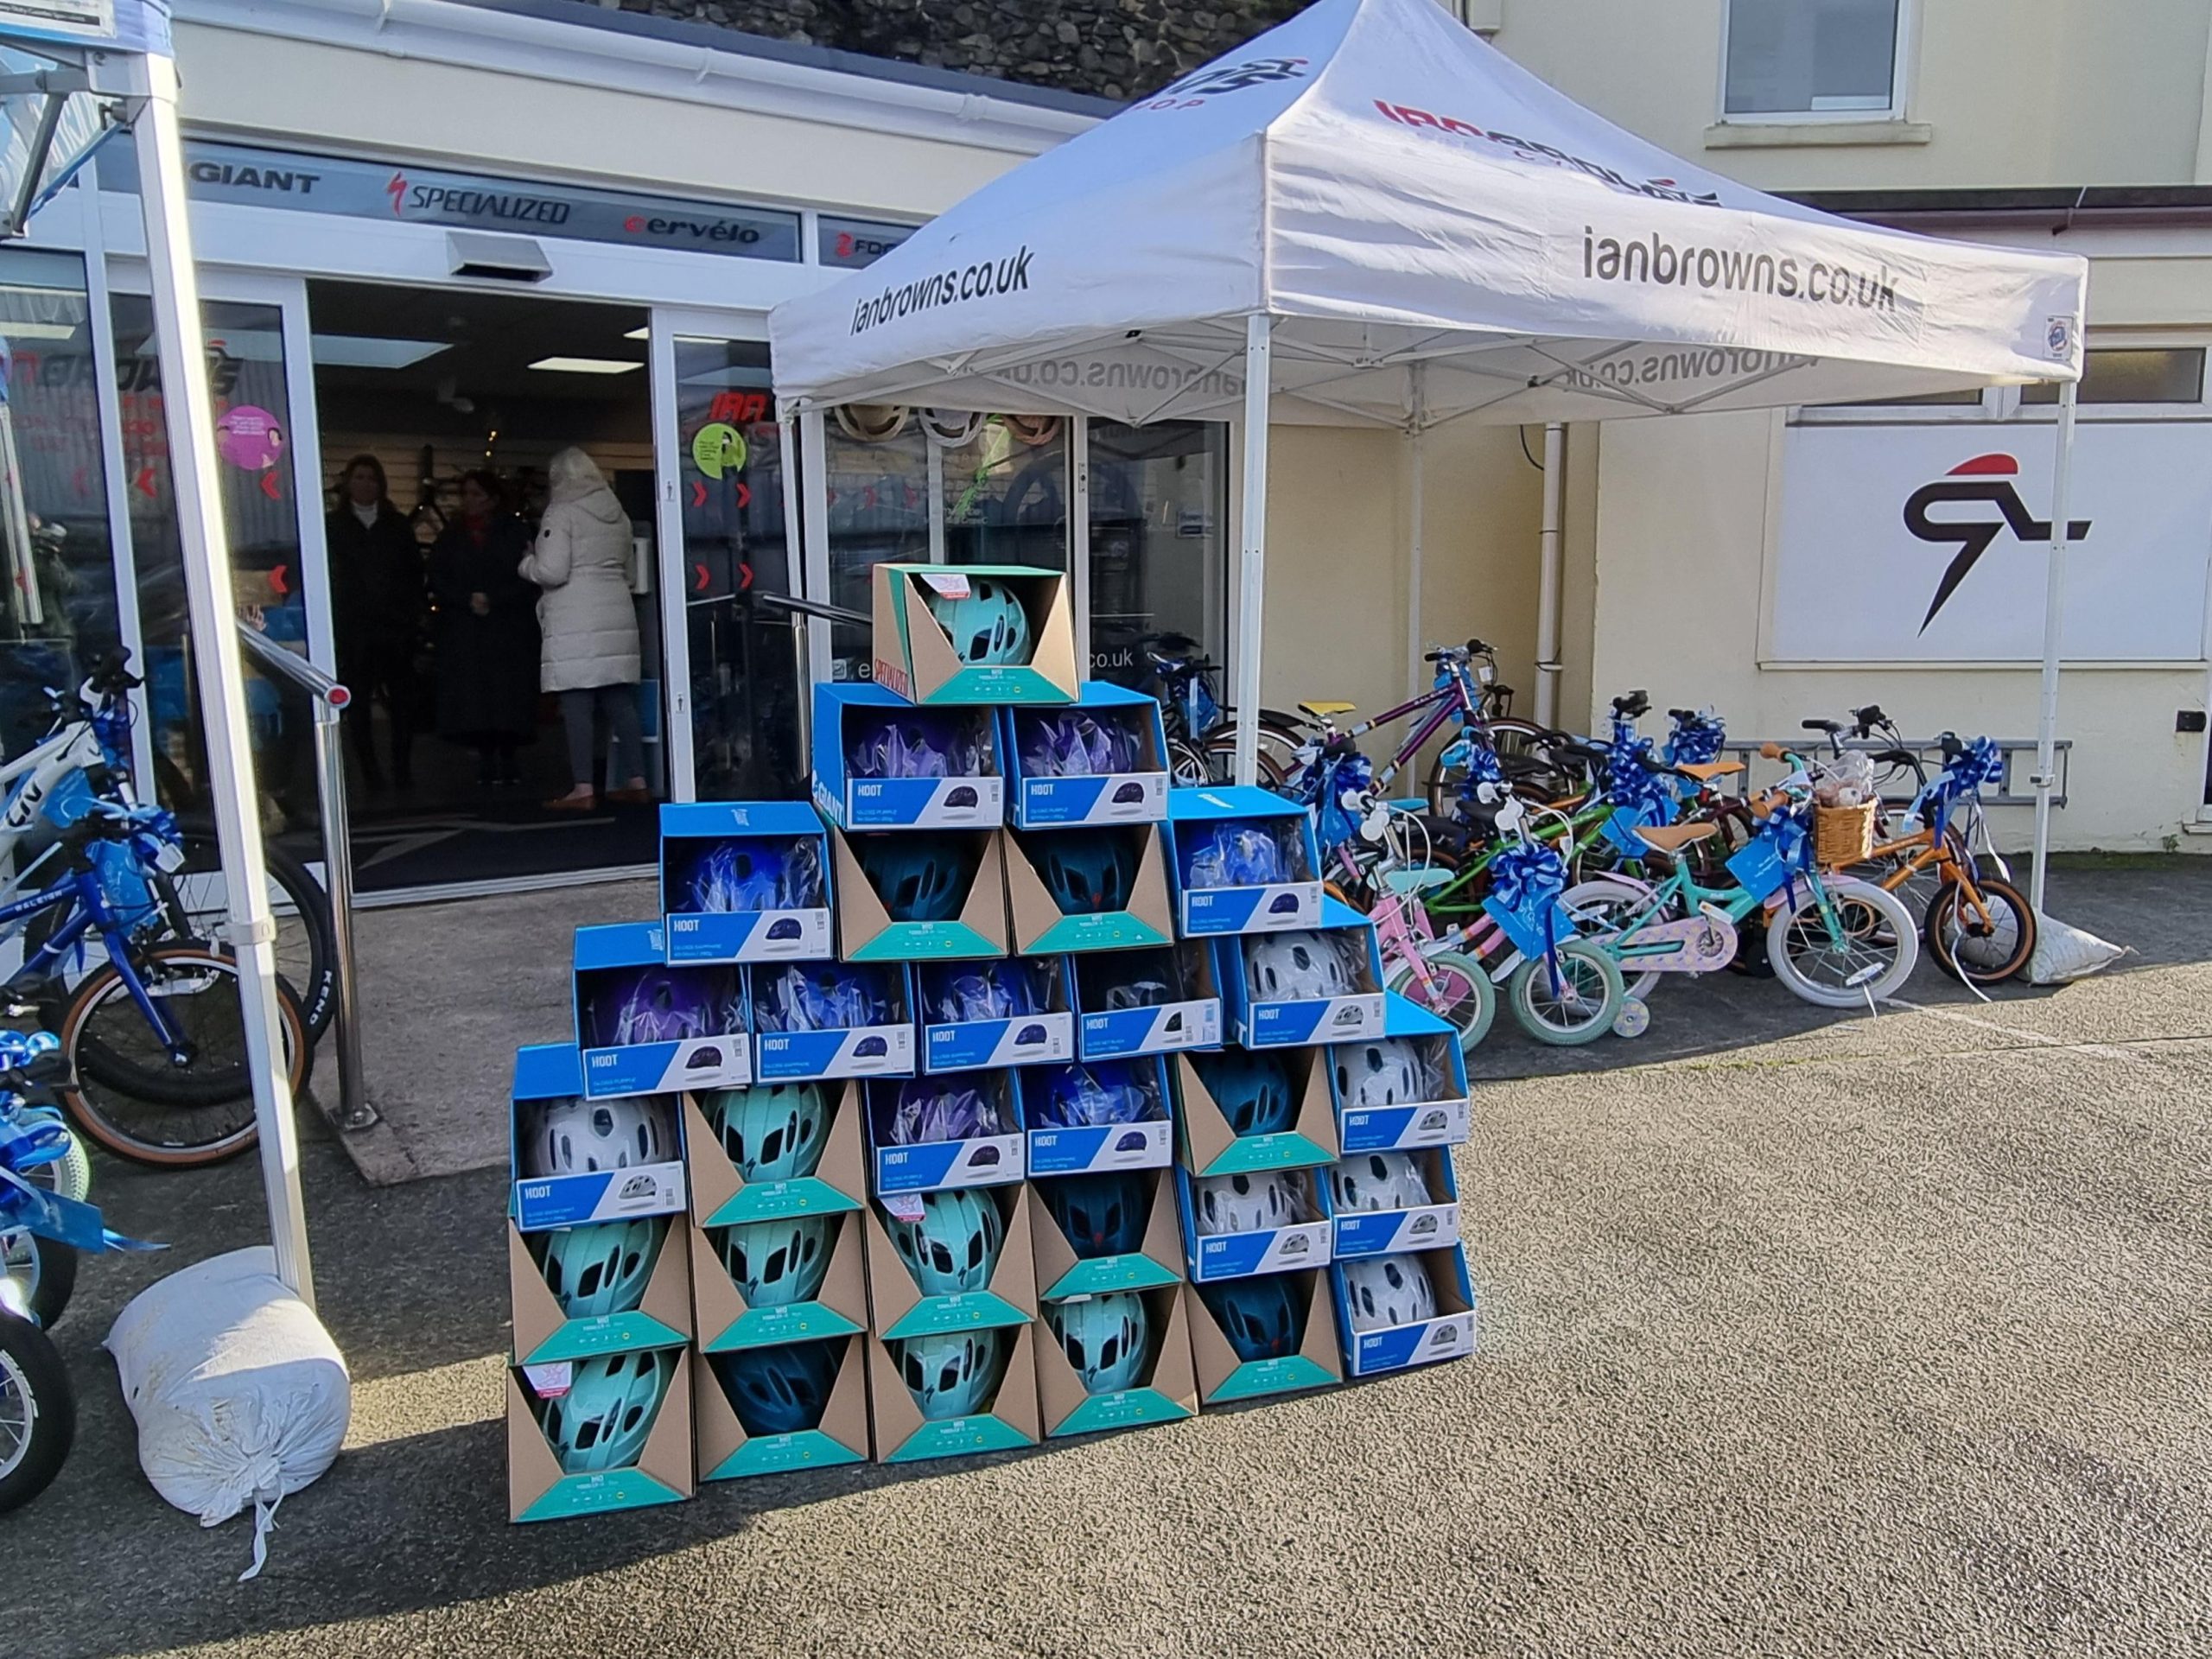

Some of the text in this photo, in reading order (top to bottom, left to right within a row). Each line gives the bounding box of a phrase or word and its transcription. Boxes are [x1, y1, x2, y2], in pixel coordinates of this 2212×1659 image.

[188, 162, 320, 194] GIANT
[409, 185, 571, 225] SPECIALIZED
[1584, 226, 1899, 313] ianbrowns.co.uk
[850, 245, 1035, 336] ianbrowns.co.uk
[857, 784, 882, 797] HOOT
[1031, 784, 1053, 796] HOOT
[673, 919, 699, 932] HOOT
[932, 1030, 956, 1042] HOOT
[764, 1038, 790, 1051] HOOT
[591, 1053, 618, 1067] HOOT
[1034, 1135, 1058, 1147] HOOT
[885, 1152, 908, 1165] HOOT
[524, 1185, 551, 1199] HOOT
